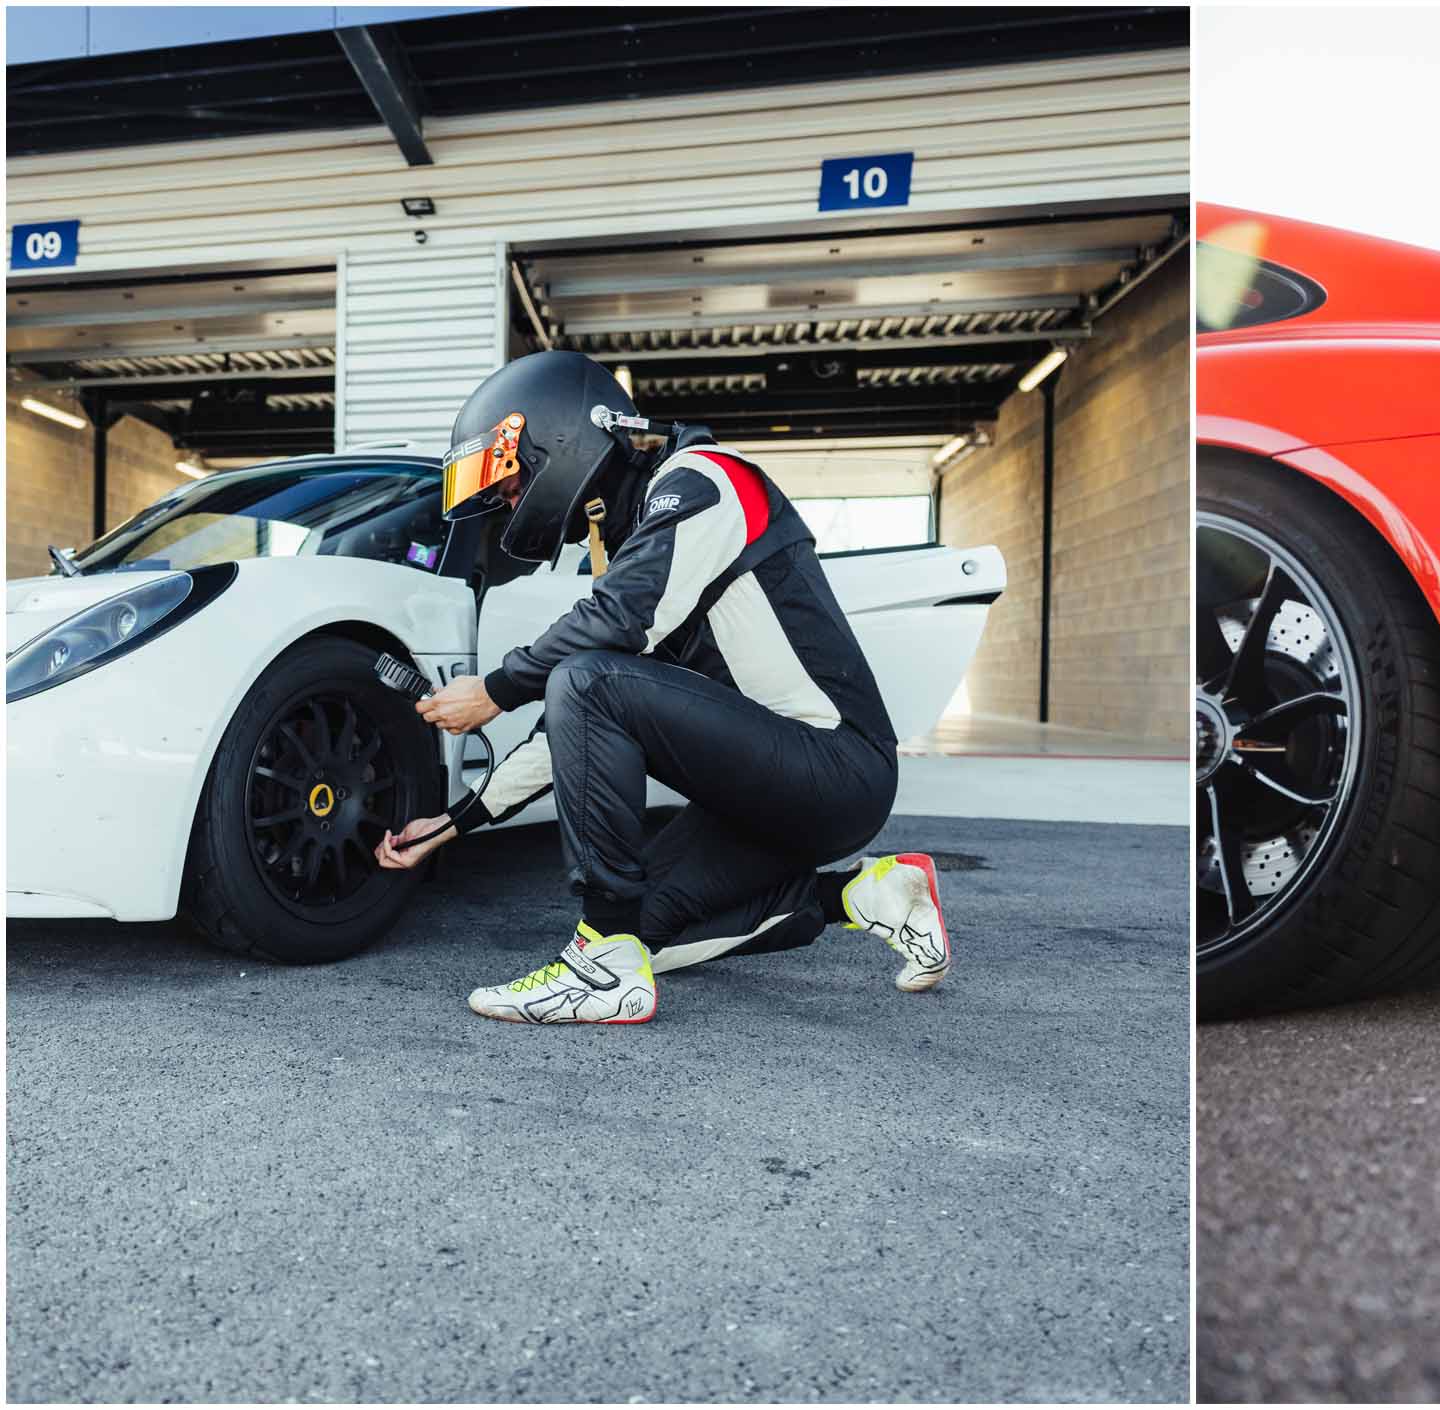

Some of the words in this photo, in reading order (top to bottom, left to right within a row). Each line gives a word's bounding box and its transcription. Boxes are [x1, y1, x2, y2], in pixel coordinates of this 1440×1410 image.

[843, 167, 888, 199] 10
[26, 231, 62, 260] 09
[649, 498, 680, 513] OMP
